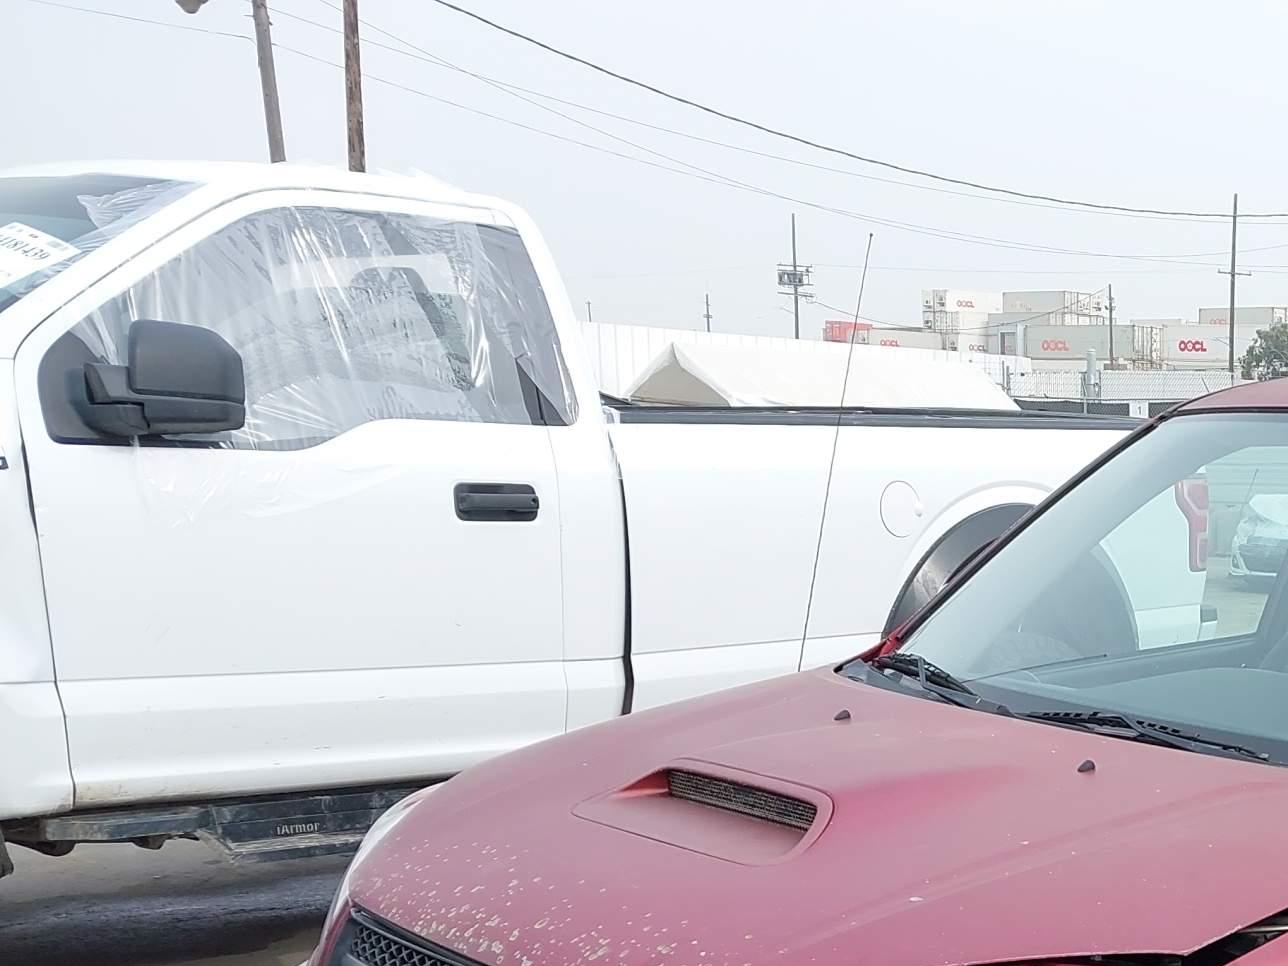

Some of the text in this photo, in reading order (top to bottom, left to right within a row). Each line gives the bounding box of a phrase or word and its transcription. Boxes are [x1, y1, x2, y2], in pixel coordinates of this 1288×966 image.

[956, 299, 975, 309] OOCL
[880, 338, 899, 347] OOCL
[1041, 339, 1069, 351] OOCL
[1178, 339, 1207, 352] OOCL
[968, 343, 985, 352] OOCL
[1138, 407, 1143, 416] 1
